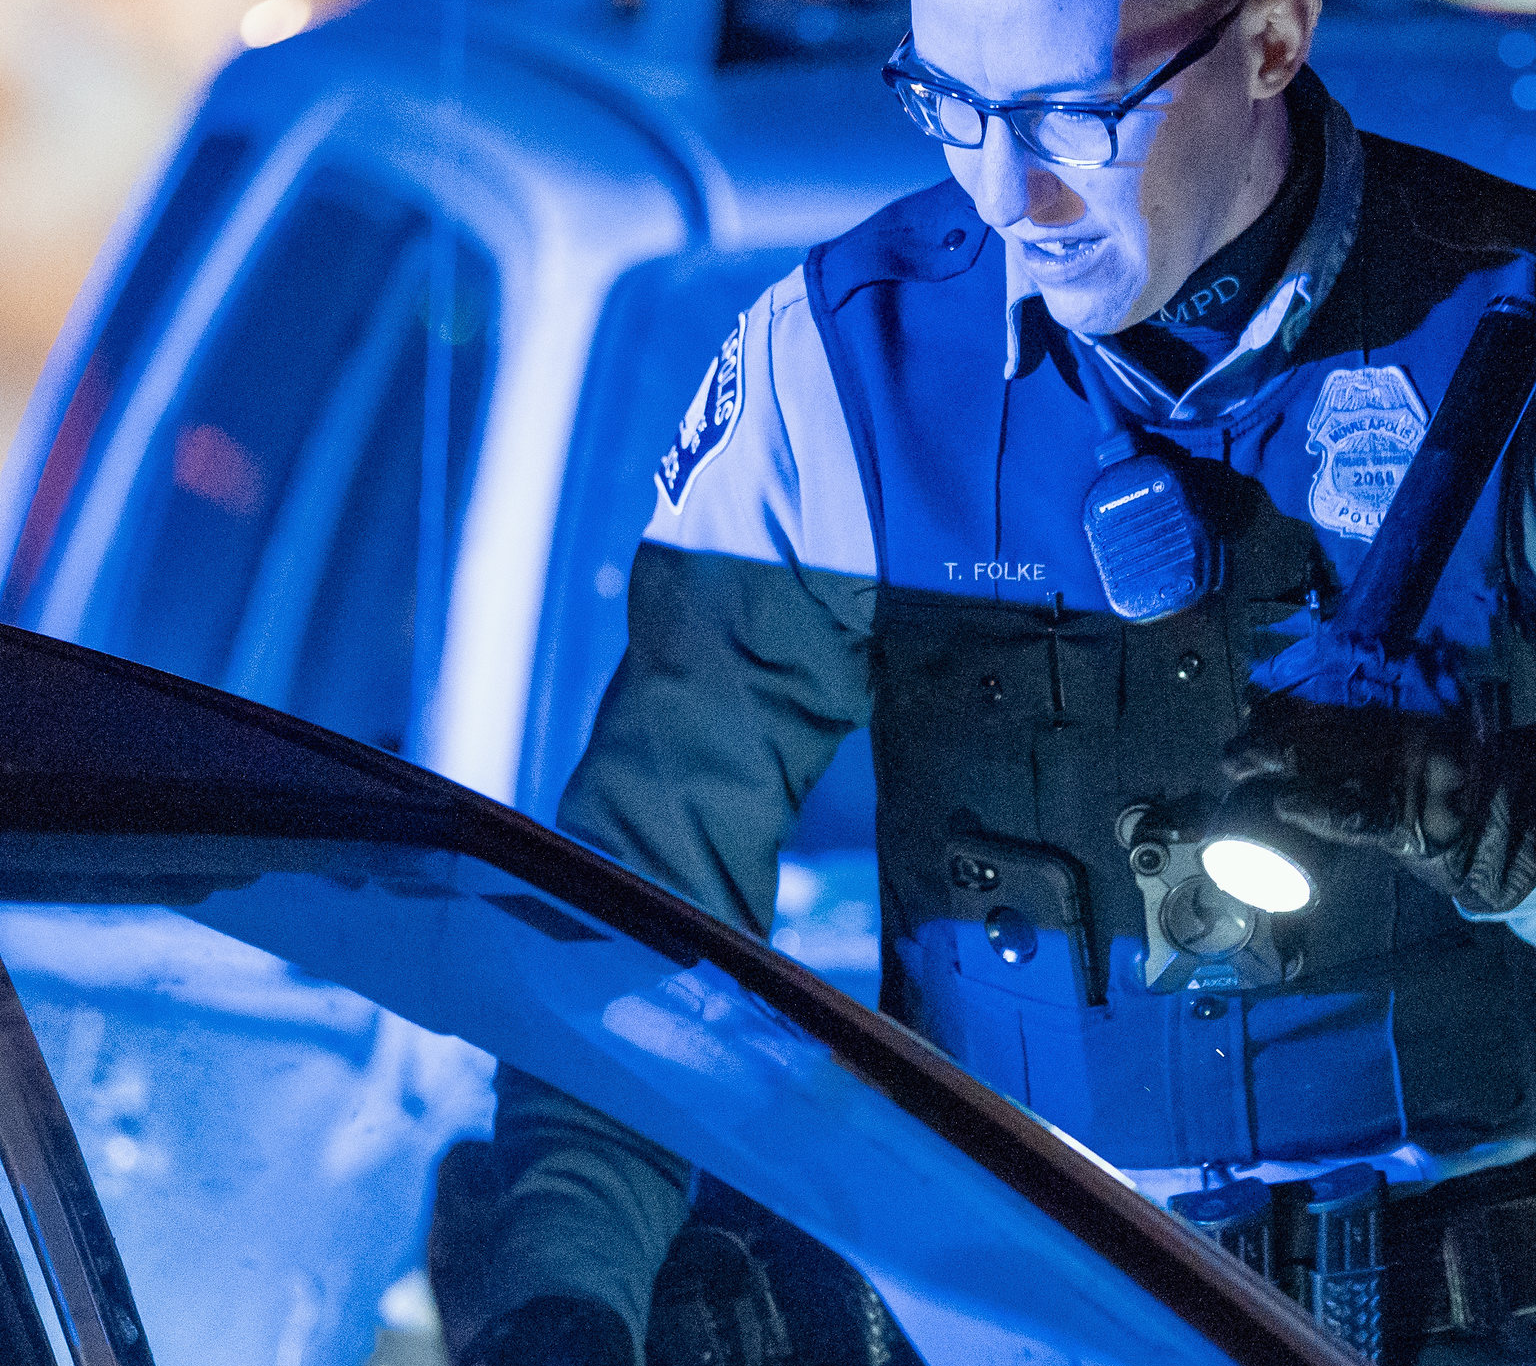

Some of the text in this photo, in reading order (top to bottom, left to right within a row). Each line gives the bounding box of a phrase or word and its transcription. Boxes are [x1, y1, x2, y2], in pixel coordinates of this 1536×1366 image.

[1159, 276, 1240, 323] MPD
[1329, 417, 1412, 444] MINNEAPOLIS
[1099, 487, 1149, 513] MOTOROLA
[1338, 507, 1384, 526] POLI
[944, 561, 1046, 581] T. FOLKE
